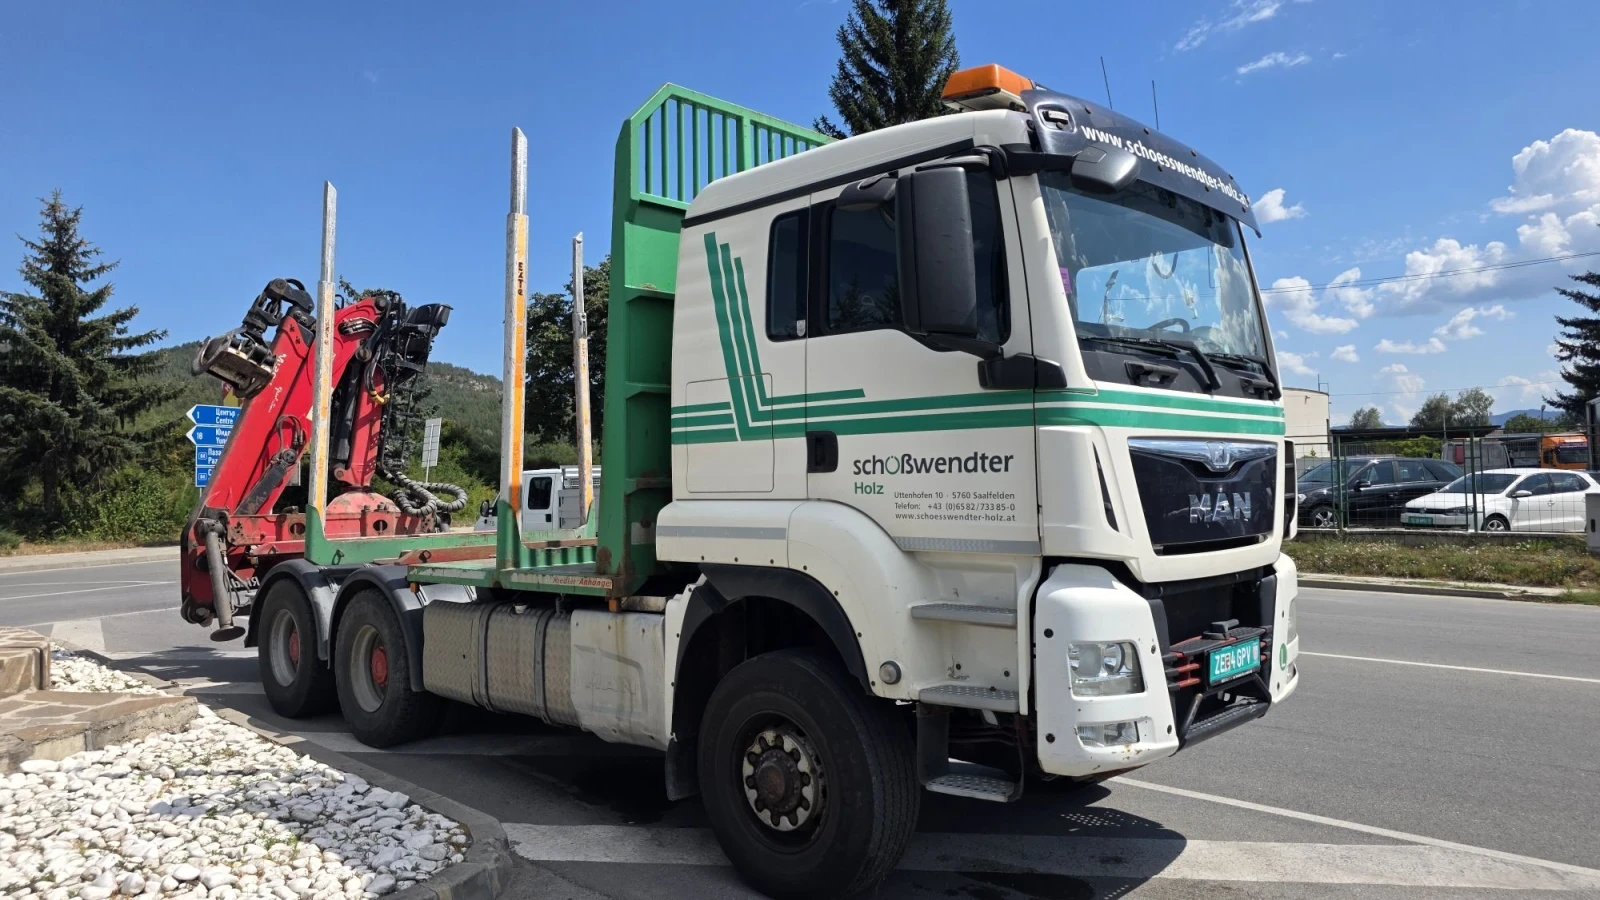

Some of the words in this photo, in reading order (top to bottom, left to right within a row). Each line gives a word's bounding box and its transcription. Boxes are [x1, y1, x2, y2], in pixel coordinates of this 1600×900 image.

[1081, 125, 1250, 206] www.schoesswendter-holz.at
[196, 411, 200, 419] 1
[215, 416, 234, 425] Centre
[196, 432, 203, 440] 18
[854, 482, 884, 495] Holz
[894, 491, 933, 499] Uttenhofen
[973, 492, 1015, 500] Saalfelden
[894, 502, 921, 510] Telefon:
[1188, 491, 1252, 524] MAN
[895, 513, 1016, 522] www.schoesswendter-holz.at
